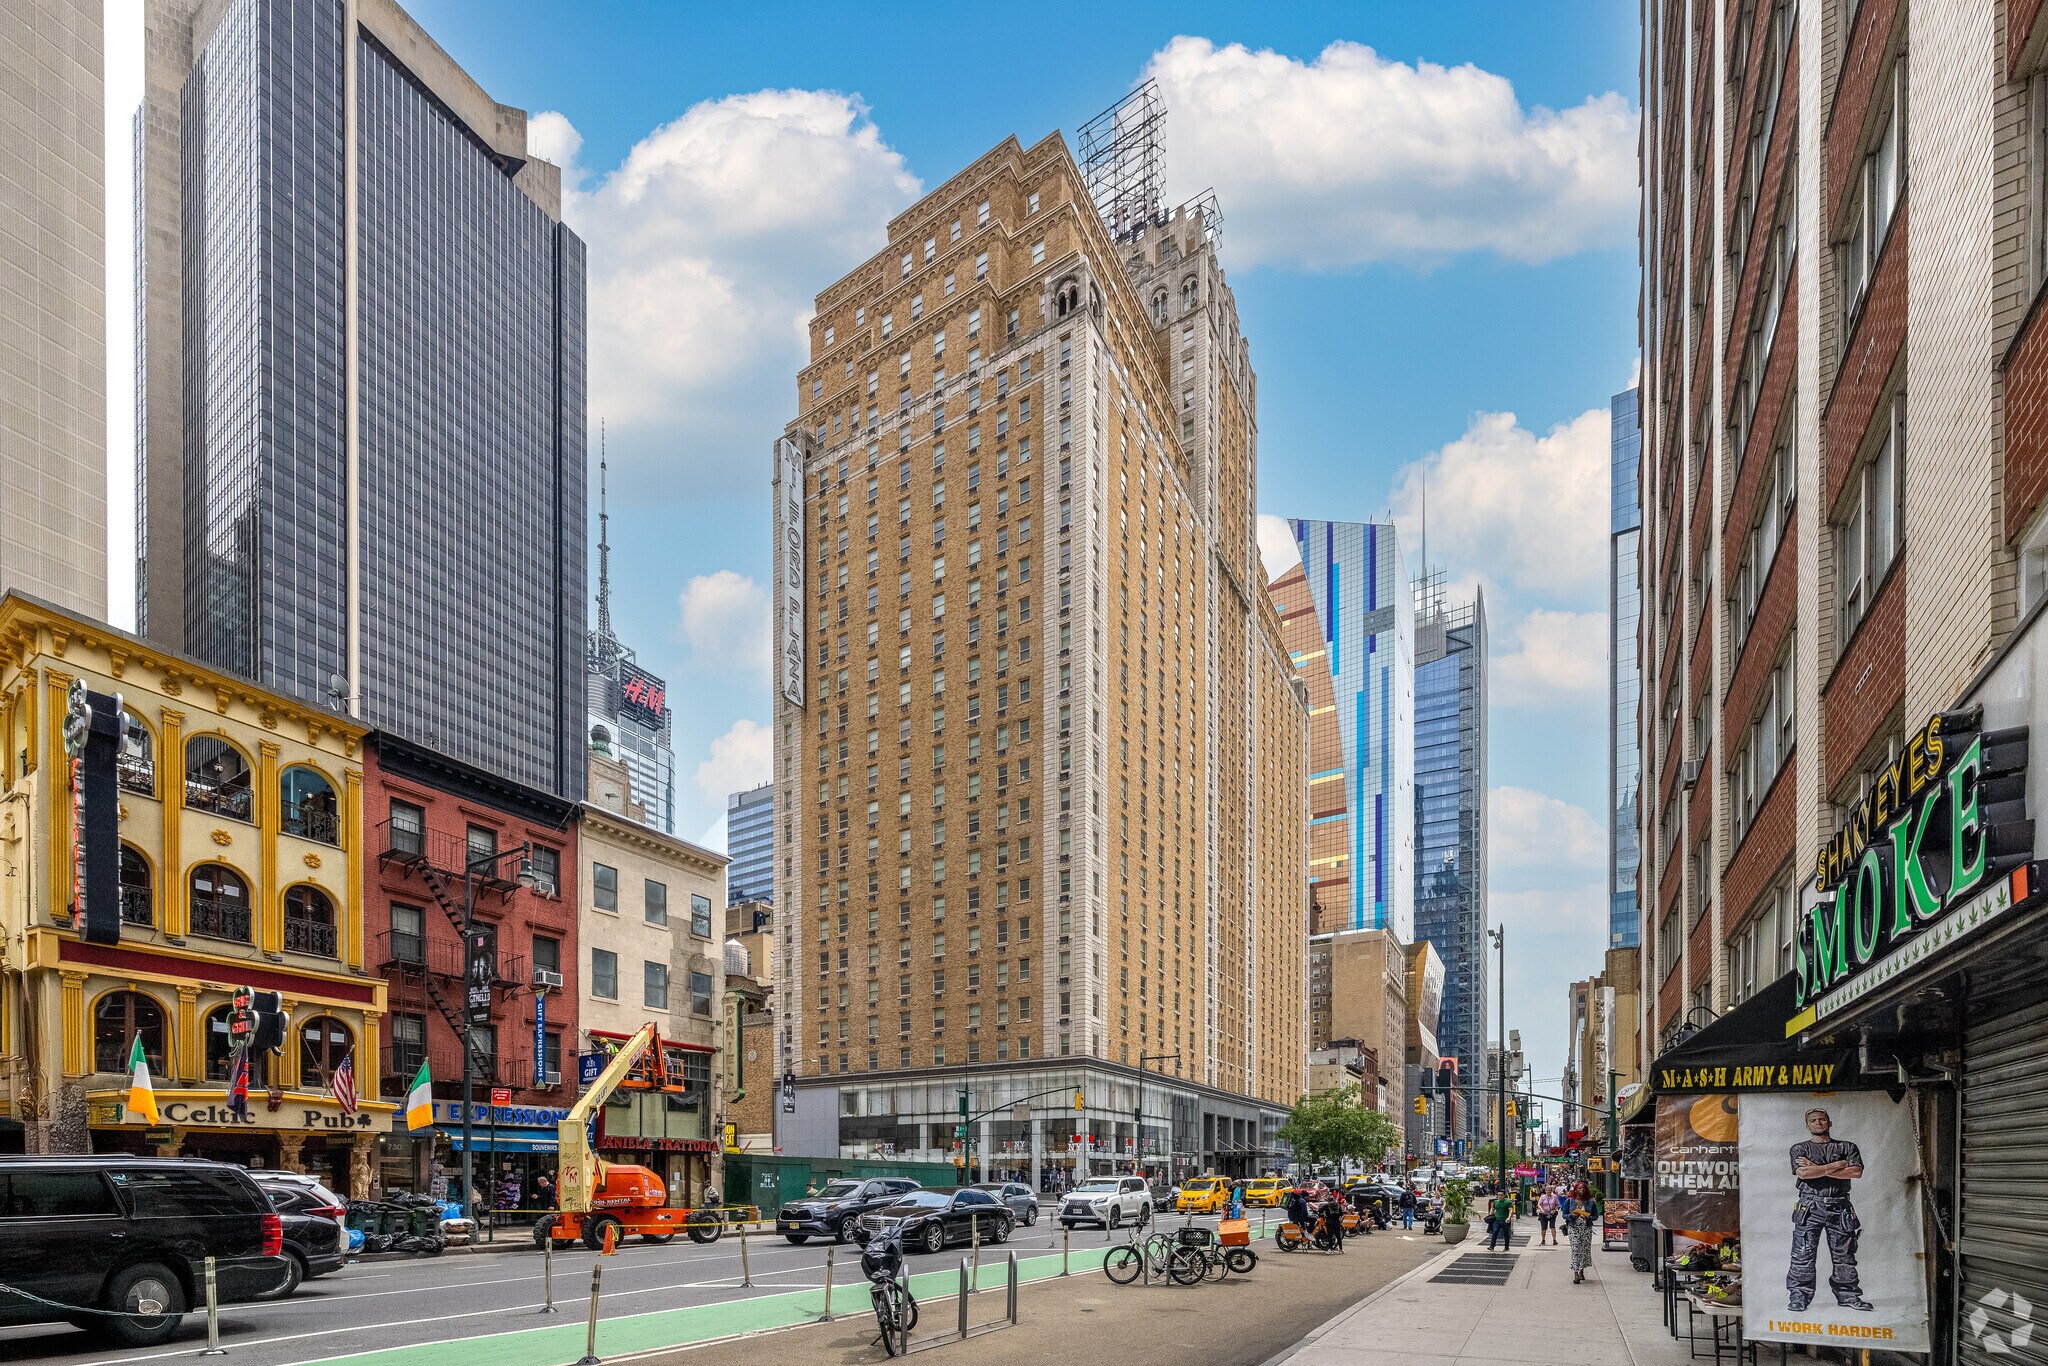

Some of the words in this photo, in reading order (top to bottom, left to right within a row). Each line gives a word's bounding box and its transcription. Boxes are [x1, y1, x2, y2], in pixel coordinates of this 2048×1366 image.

[785, 443, 801, 589] MILFORD
[787, 602, 801, 702] PLAZA
[624, 676, 664, 716] H&M
[1817, 790, 1873, 892] SHAKY
[1877, 716, 1944, 828] EYES
[1796, 732, 1986, 1009] SMOKE
[725, 1005, 735, 1090] DANIELA
[584, 1068, 597, 1077] GIFT
[1732, 1066, 1775, 1087] ARMY
[1778, 1065, 1788, 1085] &
[1792, 1064, 1834, 1085] NAVY
[165, 1103, 255, 1124] Celtic
[303, 1110, 355, 1128] Pub
[603, 1136, 651, 1149] ANIELA
[659, 1139, 719, 1152] TRATTORIA
[1068, 1143, 1081, 1151] NY
[1669, 1145, 1738, 1154] carhart
[1658, 1174, 1713, 1189] THEM
[1769, 1320, 1773, 1332] I
[1777, 1321, 1822, 1335] WORK
